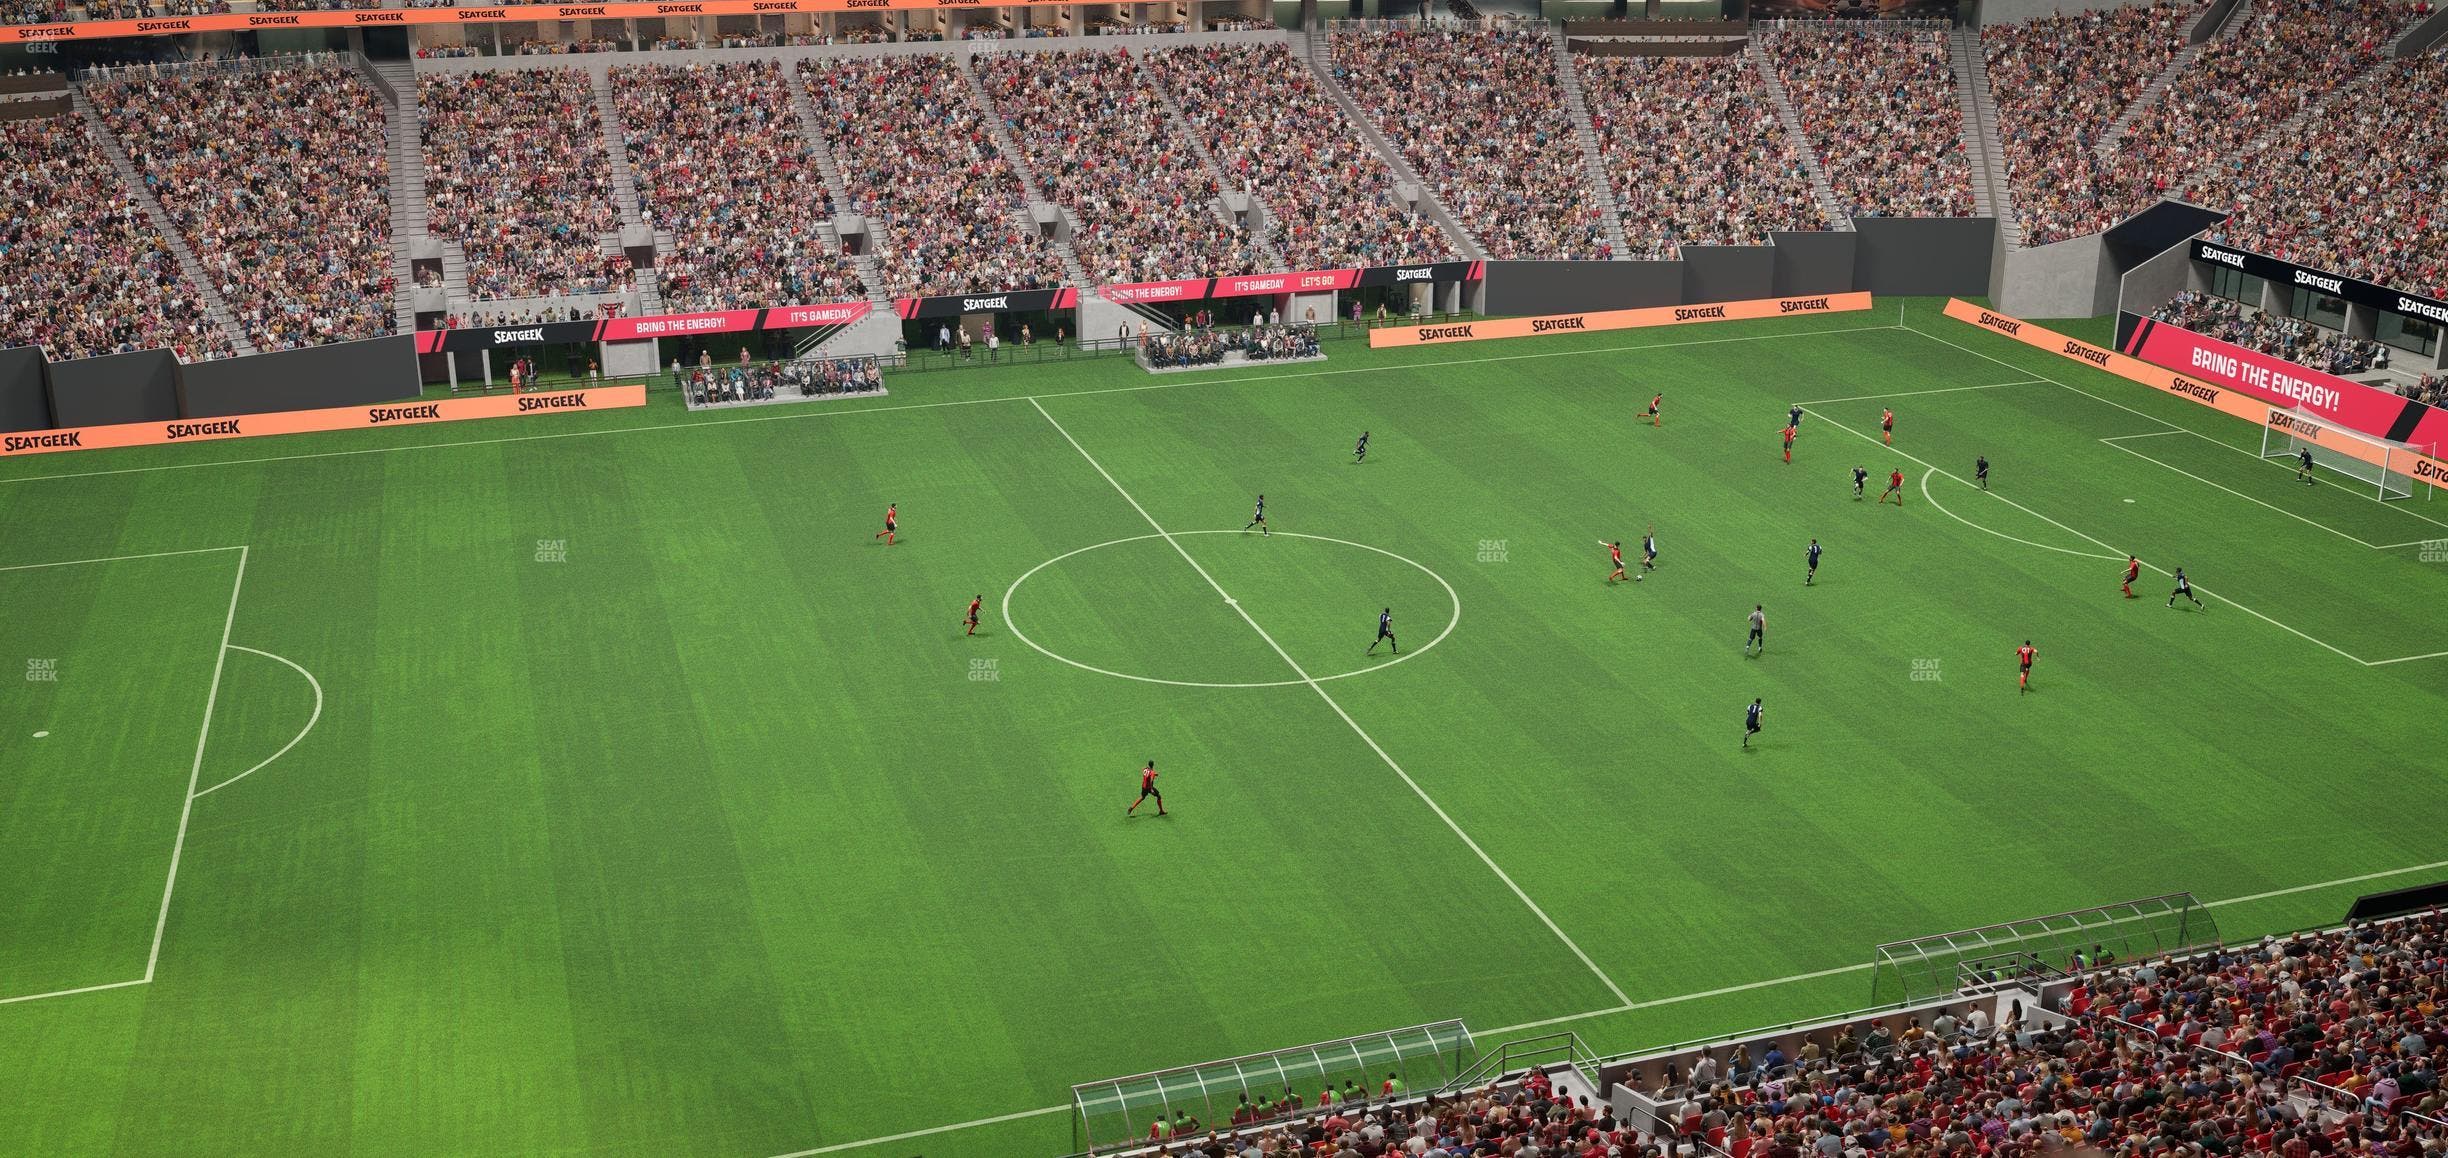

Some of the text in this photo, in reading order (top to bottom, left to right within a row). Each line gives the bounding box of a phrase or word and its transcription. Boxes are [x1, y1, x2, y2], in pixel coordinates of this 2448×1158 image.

[560, 7, 605, 16] SEATGEEK
[658, 4, 702, 13] SEATGEEK
[754, 2, 797, 10] SEATGEEK
[250, 15, 299, 25] SEATGEEK
[356, 13, 403, 22] SEATGEEK
[459, 10, 505, 19] SEATGEEK
[19, 27, 75, 38] SEATGEEK
[137, 20, 190, 31] SEATGEEK
[2202, 245, 2244, 268] SEATGEEK
[1302, 276, 1334, 287] LET'S GO!
[1397, 267, 1432, 281] SEATGEEK
[1235, 279, 1284, 291] IT'S GAMEDAY
[2295, 270, 2343, 294] SEATGEEK
[1135, 288, 1149, 298] THE
[1150, 286, 1182, 297] ENERGY!
[964, 296, 1007, 311] SEATGEEK
[1781, 298, 1829, 312] SEATGEEK
[2398, 297, 2448, 322] SEATGEEK
[791, 312, 807, 322] IT'S
[1675, 306, 1725, 321] SEATGEEK
[637, 315, 725, 333] BRING THE ENERGY!
[1533, 317, 1584, 332] SEATGEEK
[1978, 312, 2021, 335] SEATGEEK
[495, 328, 544, 344] SEATGEEK
[1419, 325, 1473, 341] SEATGEEK
[2064, 342, 2110, 366] SEATGEEK
[2192, 347, 2339, 411] BRING THE ENERGY!
[2170, 378, 2219, 403] SEATGEEK
[519, 393, 586, 411] SEATGEEK
[370, 404, 440, 423] SEATGEEK
[167, 420, 240, 439] SEATGEEK
[5, 432, 81, 451] SEATGEEK
